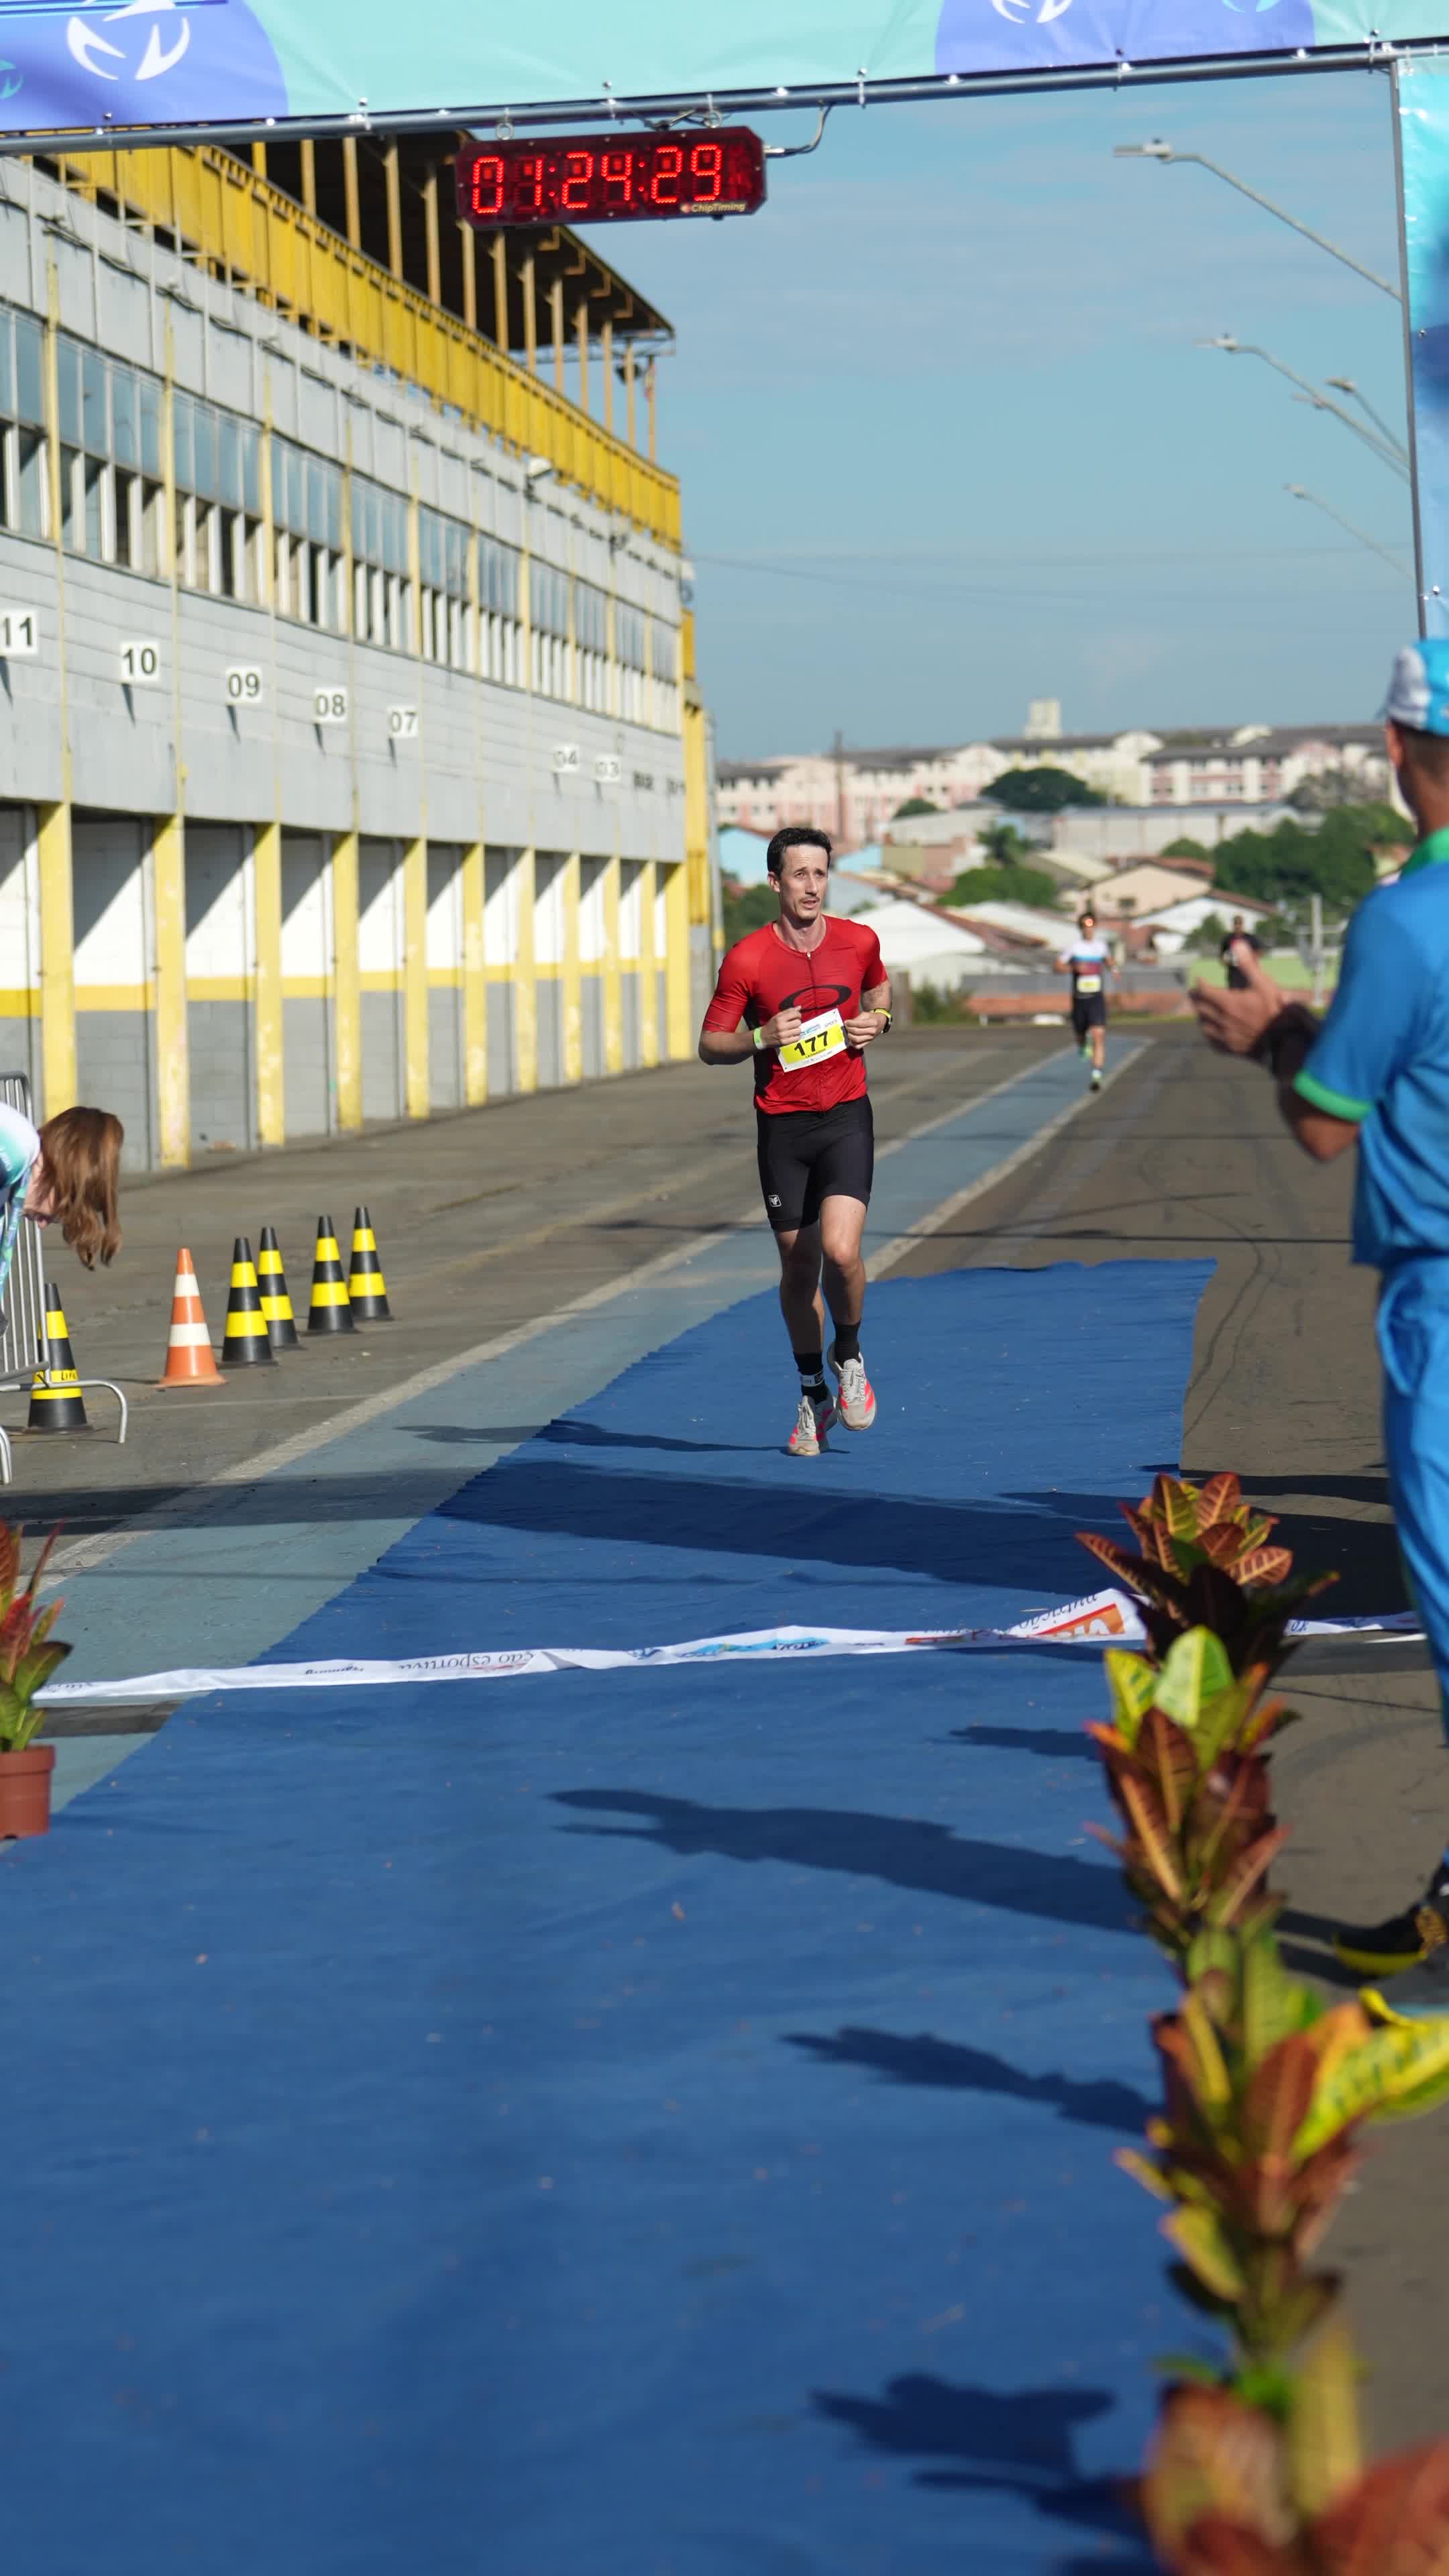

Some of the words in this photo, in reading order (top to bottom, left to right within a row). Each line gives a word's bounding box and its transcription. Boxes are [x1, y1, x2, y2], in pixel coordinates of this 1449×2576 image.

[472, 144, 722, 214] 01:24:29
[692, 203, 745, 213] ChipTiming
[2, 616, 32, 646] 11
[123, 647, 156, 674] 10
[228, 673, 260, 697] 09
[315, 694, 344, 716] 08
[389, 711, 417, 732] 07
[794, 1030, 828, 1056] 177
